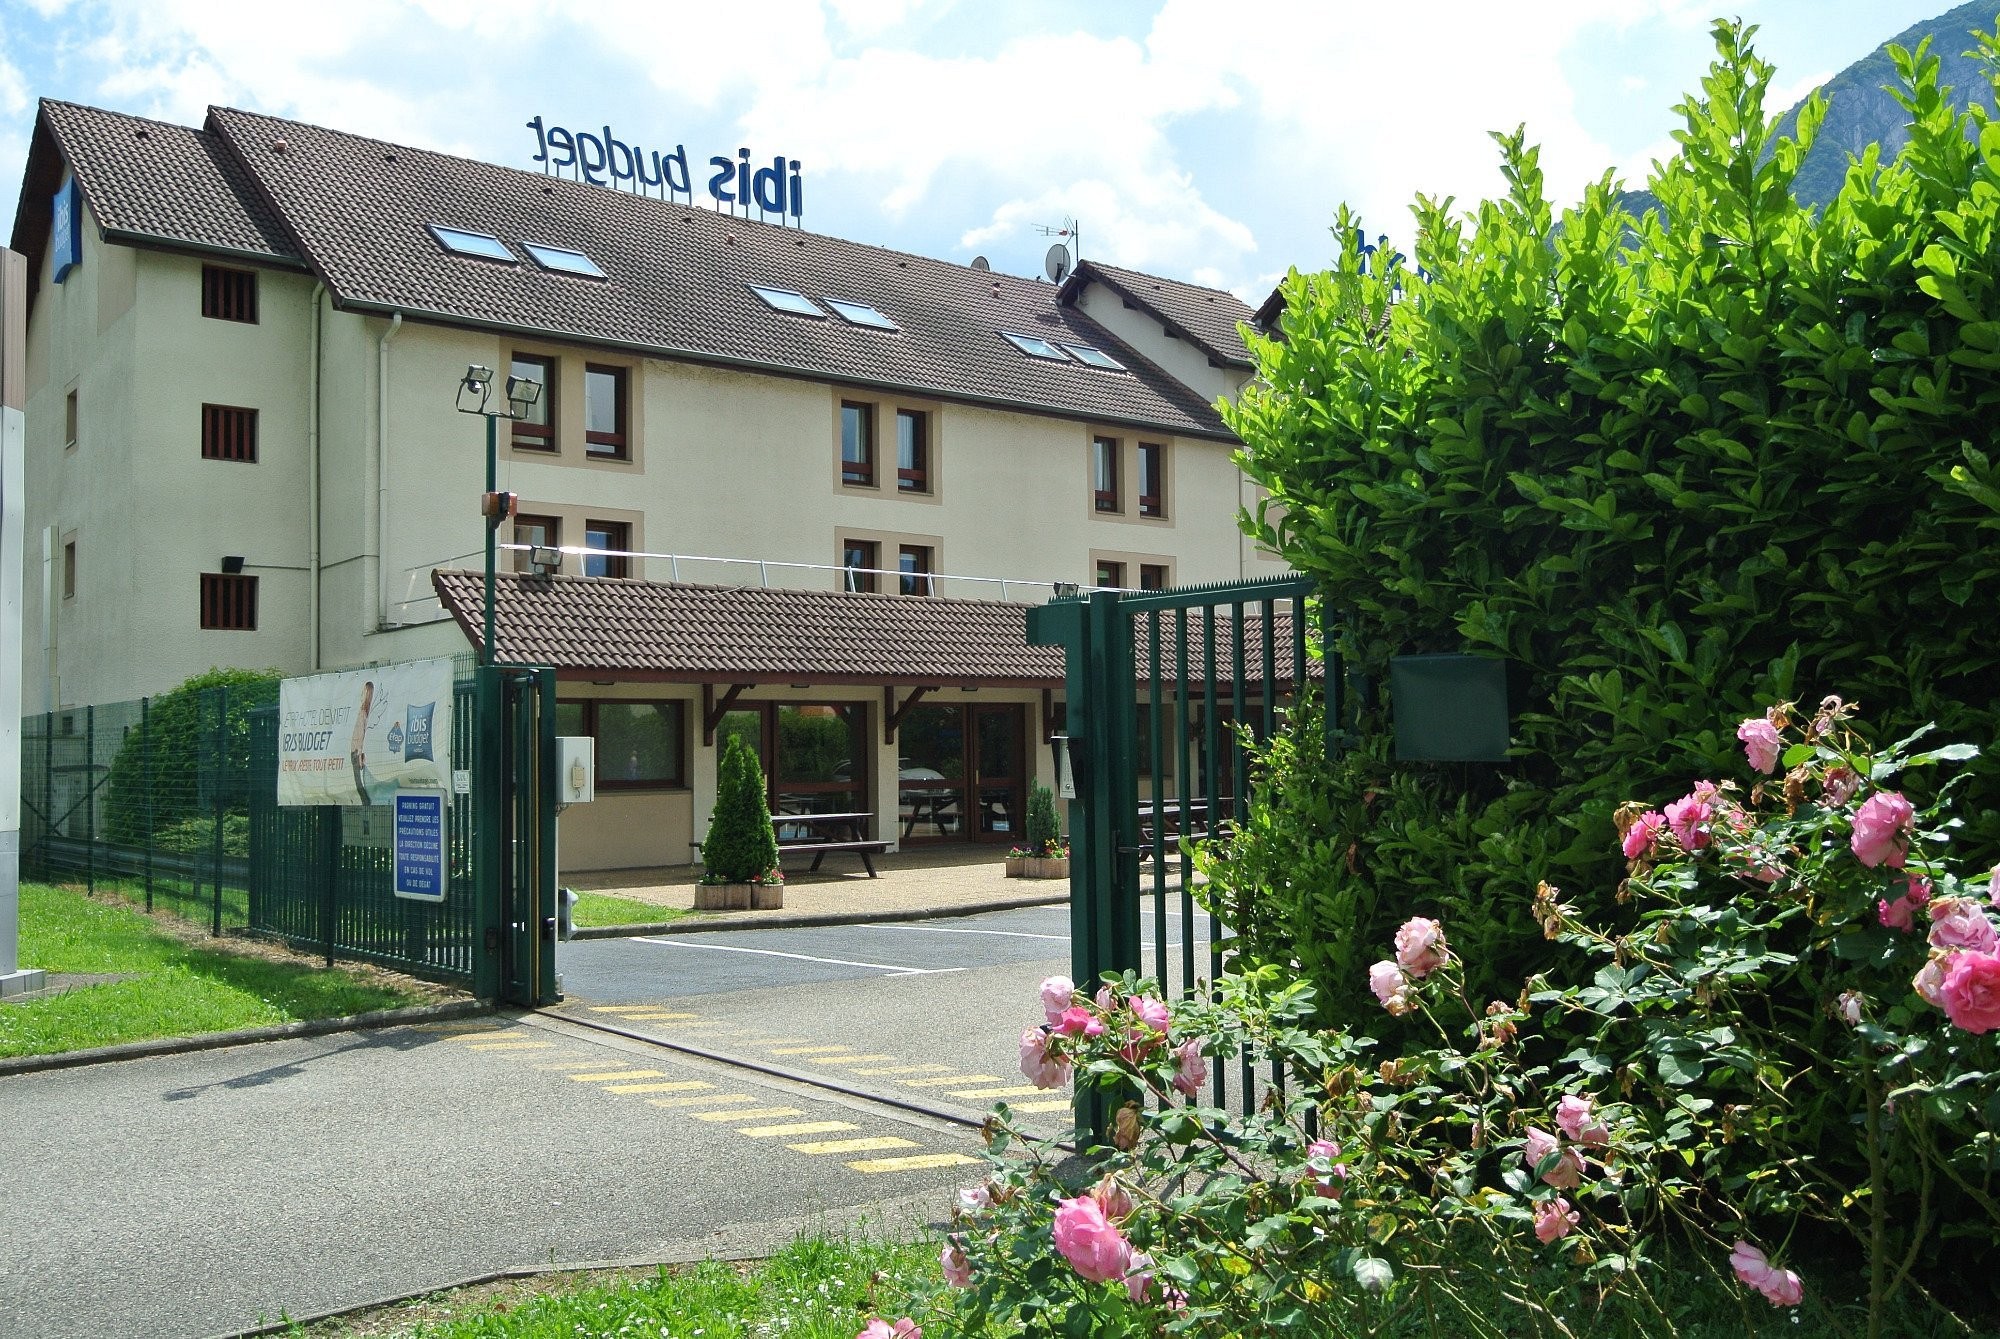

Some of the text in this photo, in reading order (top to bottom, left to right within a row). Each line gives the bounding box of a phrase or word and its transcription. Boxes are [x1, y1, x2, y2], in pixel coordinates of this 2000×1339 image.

[410, 714, 427, 733] ibis
[282, 731, 333, 752] IBIS BUDGET
[407, 732, 430, 747] budget
[313, 758, 328, 772] TOUT
[327, 757, 345, 771] PETIT
[401, 802, 435, 810] PARKING GRATUIT
[414, 815, 431, 823] PRENDRE
[424, 828, 438, 837] UTILES
[398, 840, 404, 848] LA
[404, 840, 423, 849] DIRECTION
[398, 852, 409, 861] TOUTE
[404, 865, 433, 876] EN CAS DE VOL
[412, 879, 418, 887] DE
